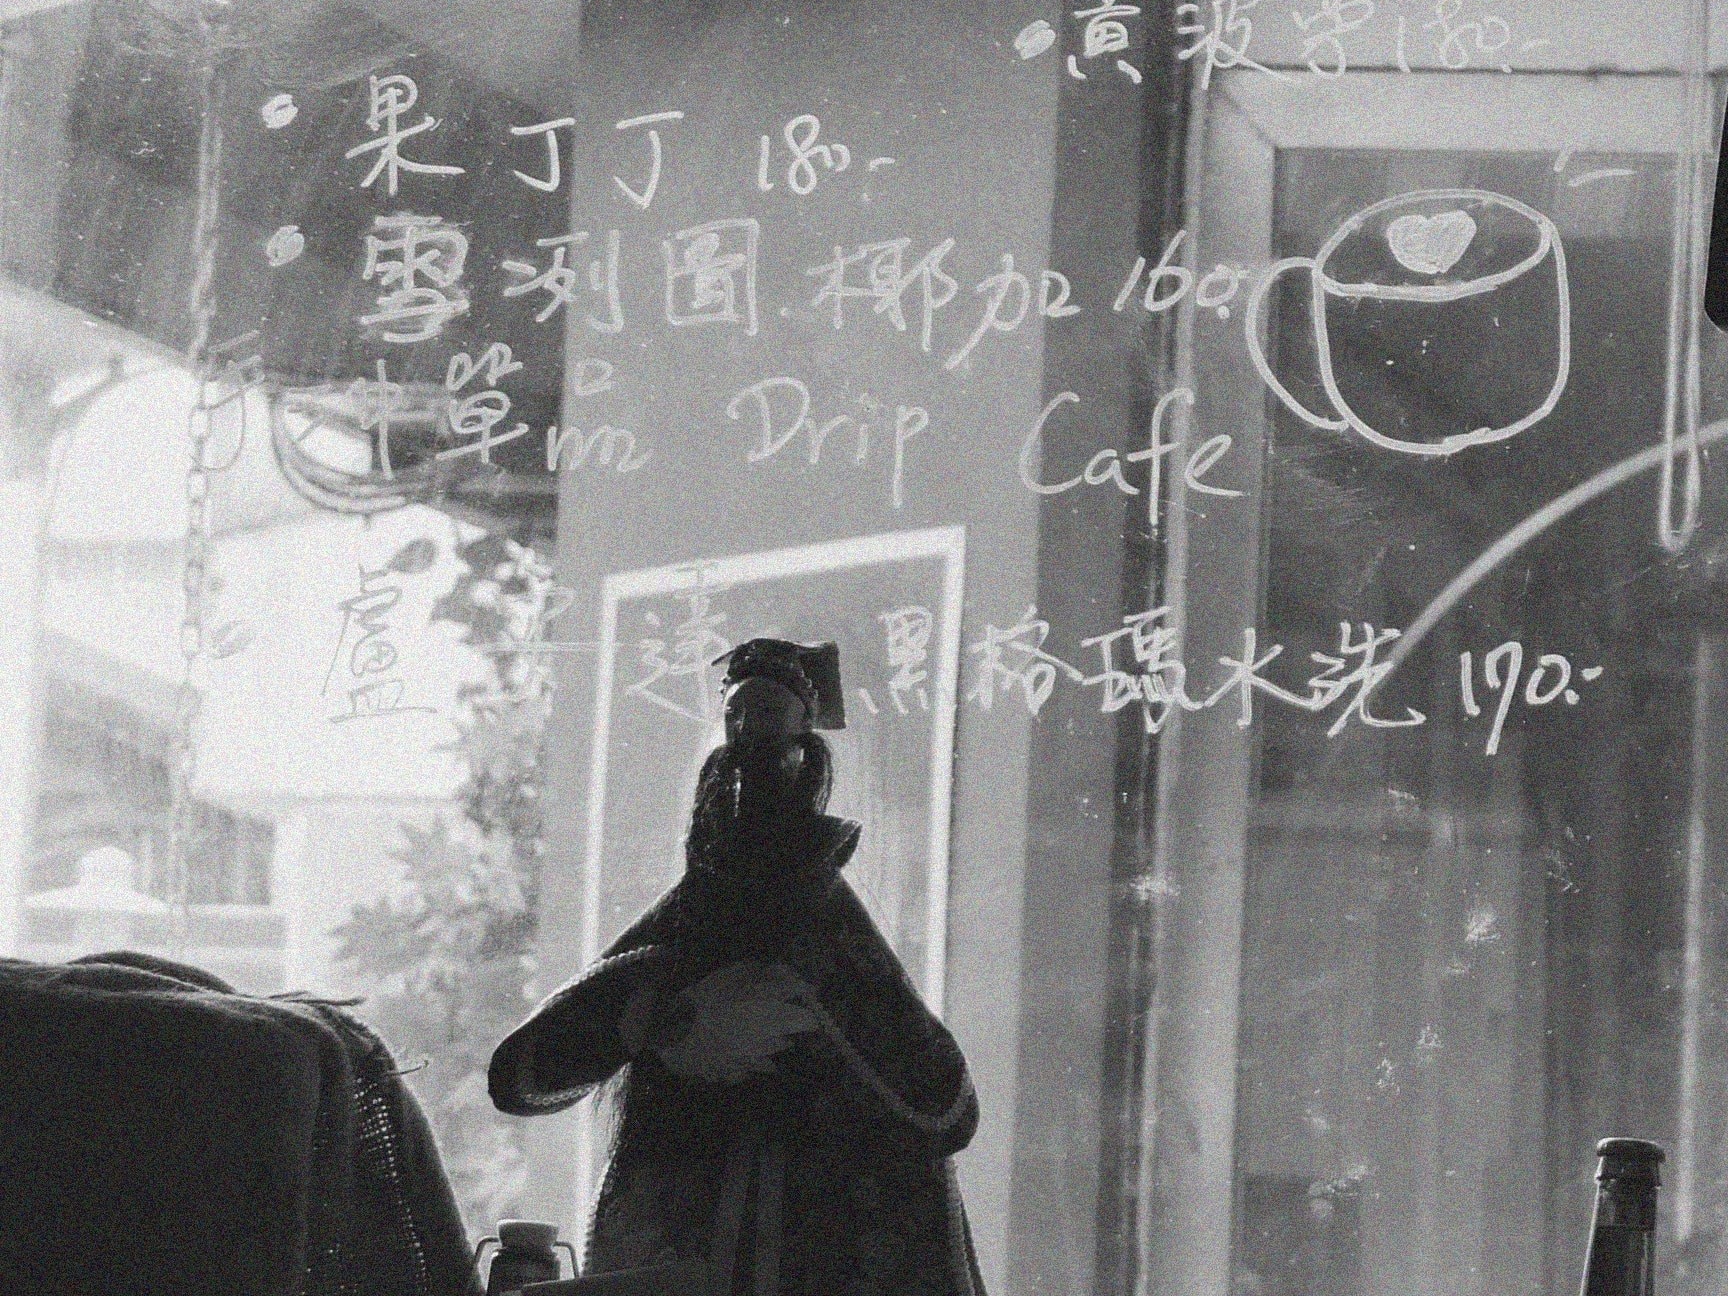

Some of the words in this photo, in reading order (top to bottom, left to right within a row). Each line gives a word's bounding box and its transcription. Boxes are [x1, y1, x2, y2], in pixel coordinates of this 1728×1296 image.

[346, 74, 685, 208] 果丁丁
[726, 375, 929, 509] Drip
[1019, 386, 1250, 526] Cafe
